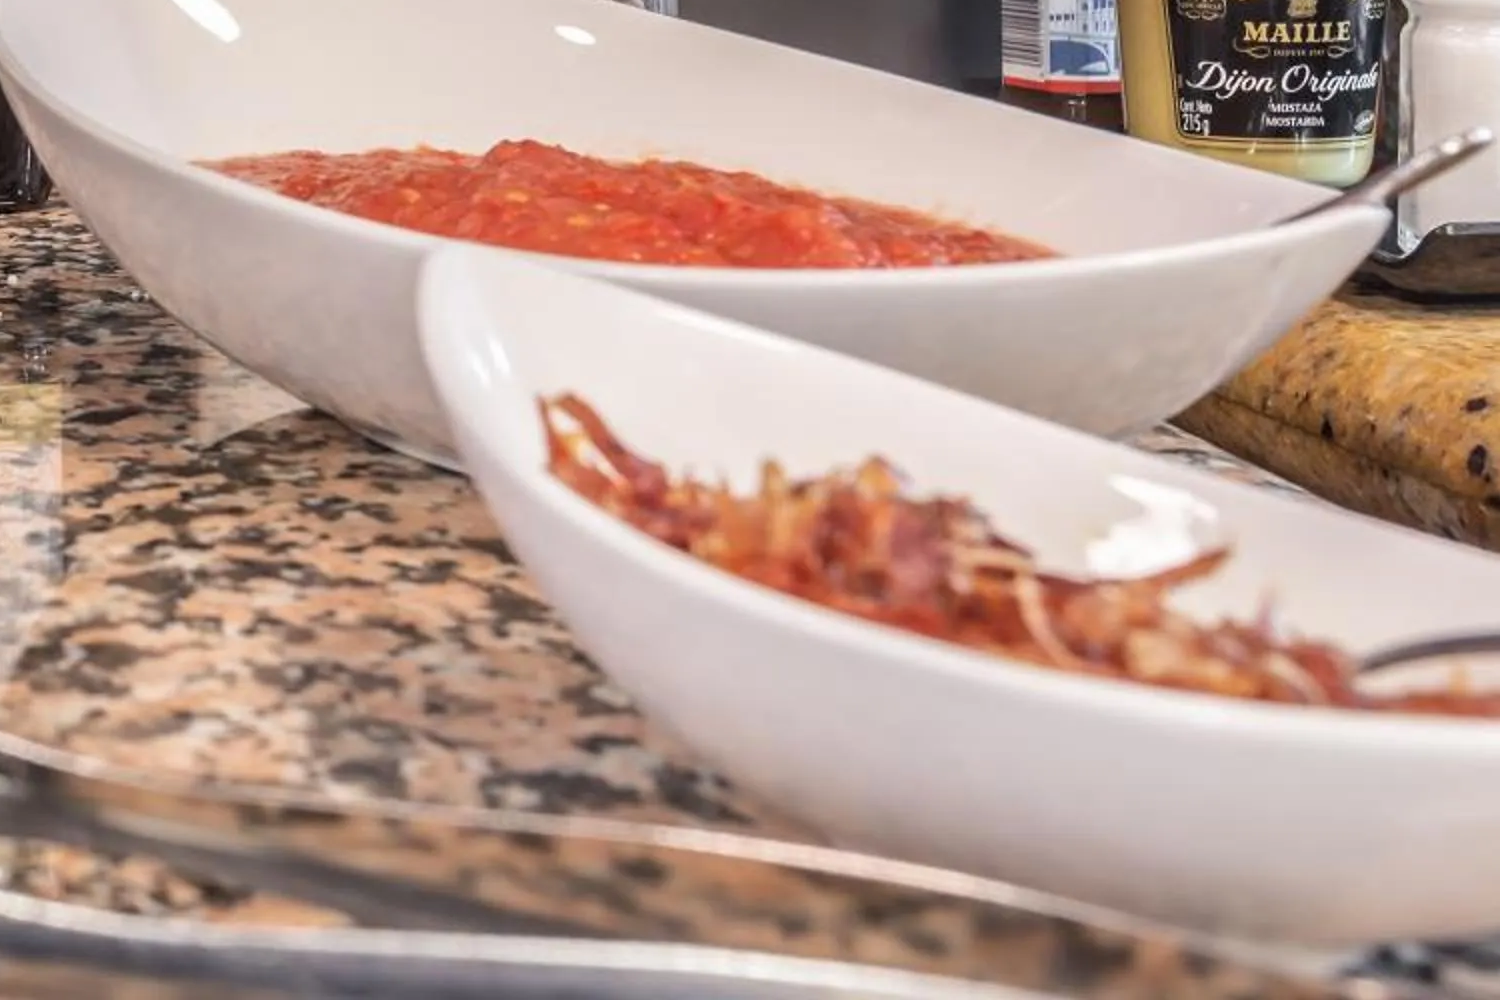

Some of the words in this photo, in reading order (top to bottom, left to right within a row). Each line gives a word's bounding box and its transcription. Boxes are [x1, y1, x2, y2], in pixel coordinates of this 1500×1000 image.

[1243, 20, 1352, 44] MAILLE
[1185, 60, 1278, 101] Dijon
[1270, 101, 1323, 114] MOSTAZA
[1264, 115, 1326, 128] MOSTARDA
